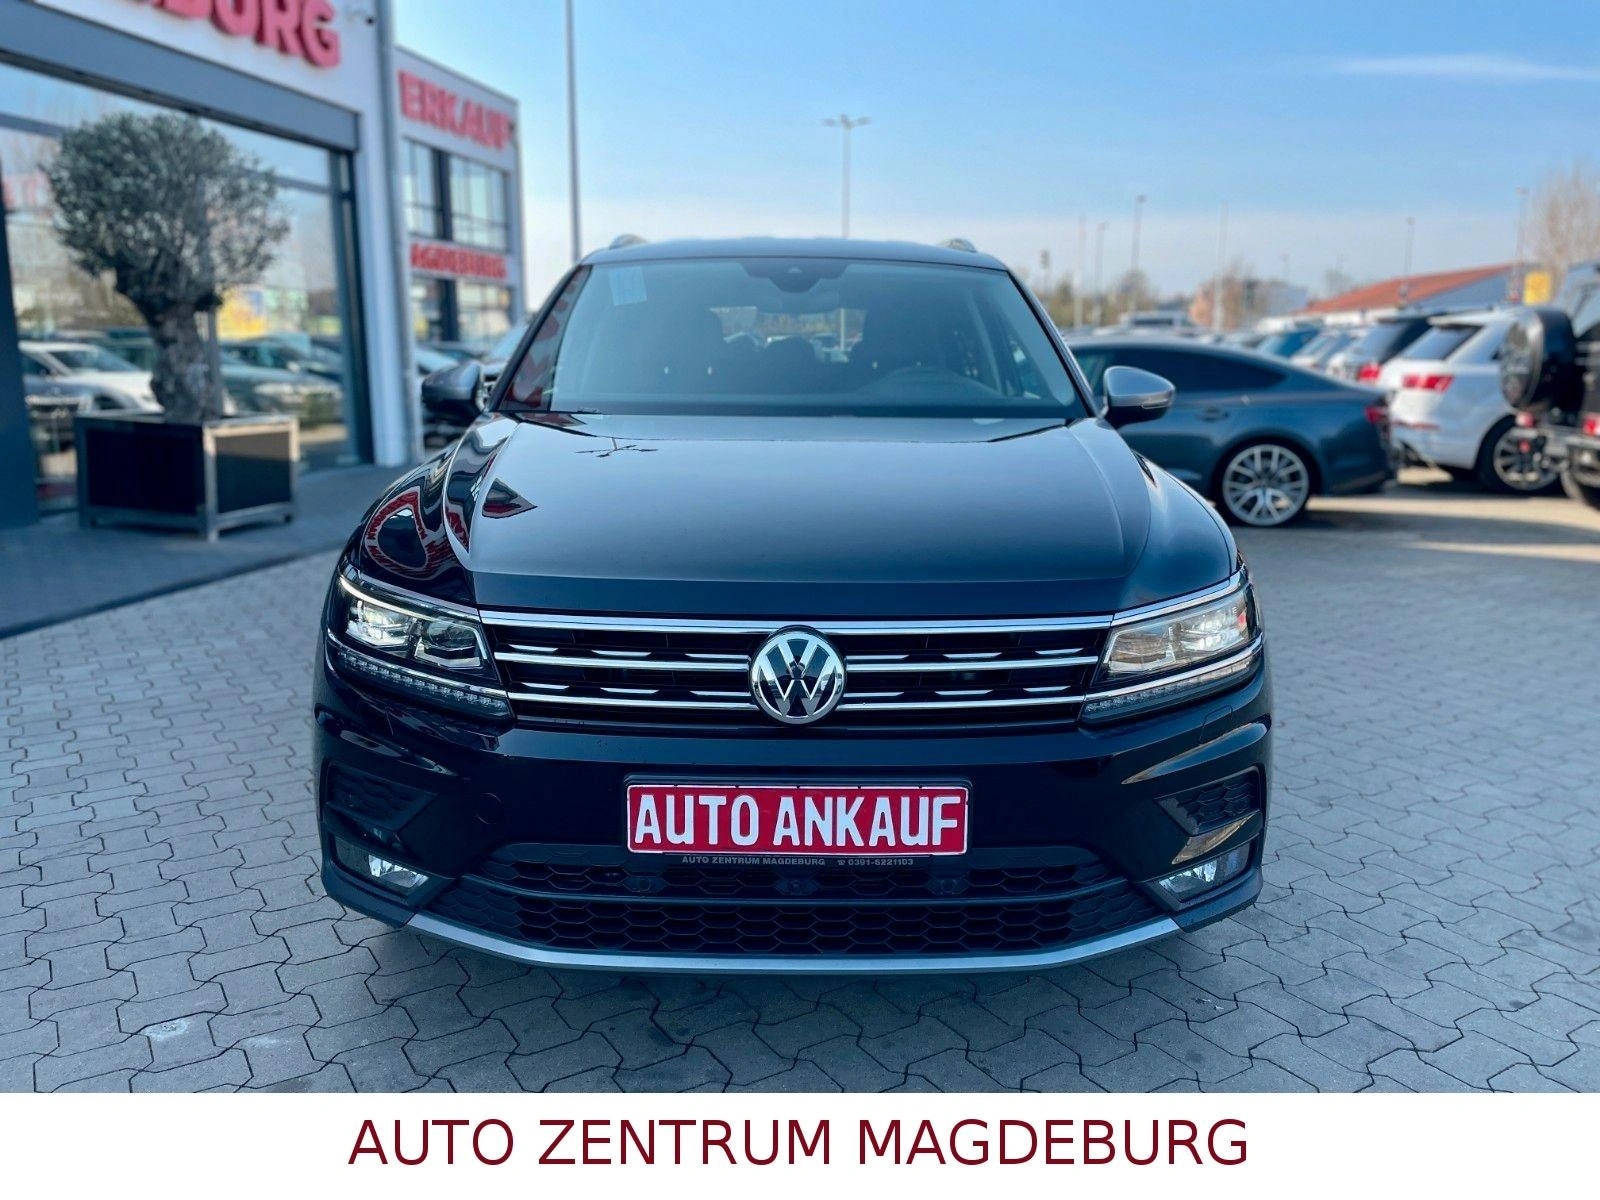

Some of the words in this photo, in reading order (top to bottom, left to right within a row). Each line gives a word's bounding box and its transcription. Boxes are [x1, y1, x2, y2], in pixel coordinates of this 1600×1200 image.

[755, 632, 842, 721] VW
[634, 794, 760, 846] AUTO
[772, 795, 961, 847] ANKAUF
[681, 855, 710, 864] AUTO
[711, 856, 761, 865] ZENTRUM
[762, 857, 826, 866] MAGDEBURG
